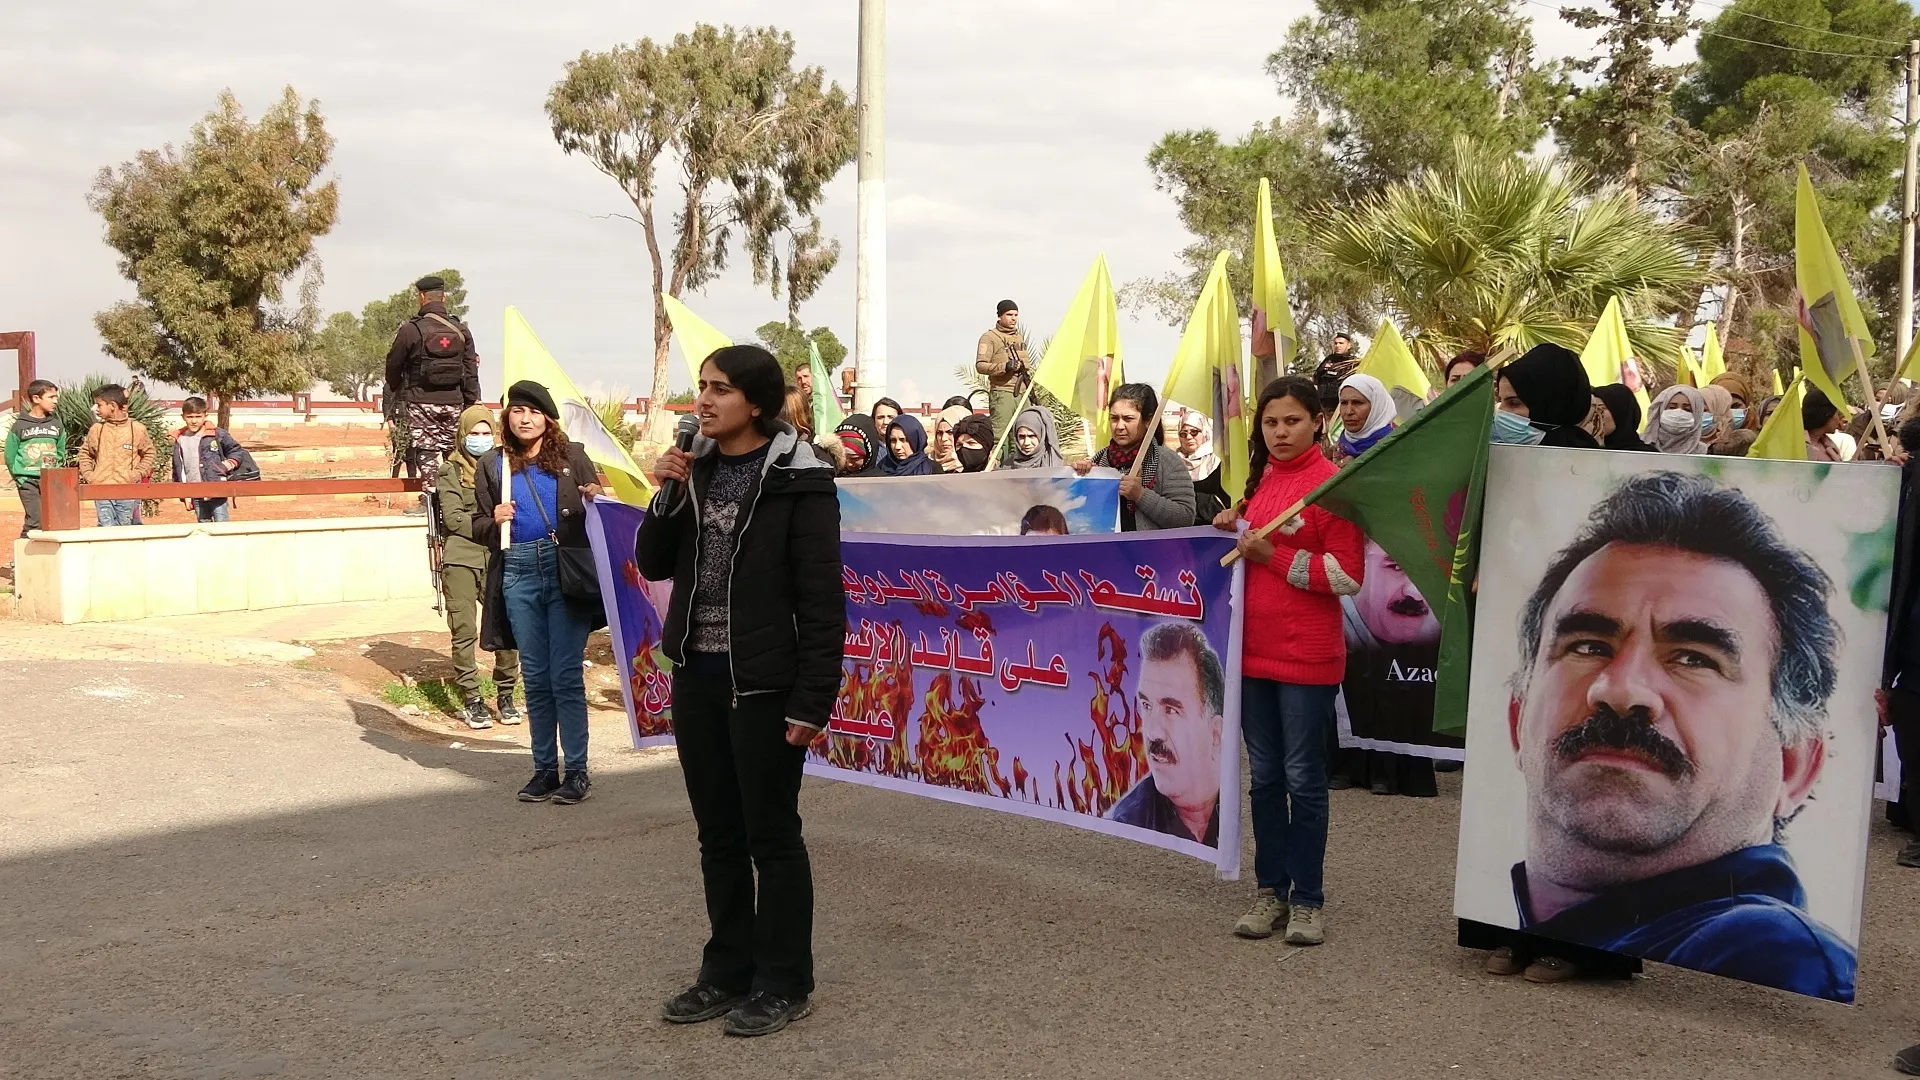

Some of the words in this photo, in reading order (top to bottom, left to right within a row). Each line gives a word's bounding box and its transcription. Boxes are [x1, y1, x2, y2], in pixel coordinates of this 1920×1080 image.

[841, 564, 934, 605] الدولي
[922, 568, 1082, 612] المؤامرة
[1078, 564, 1204, 621] تسقط
[842, 617, 906, 674] الإنس
[910, 626, 995, 676] قائد
[999, 638, 1069, 692] على
